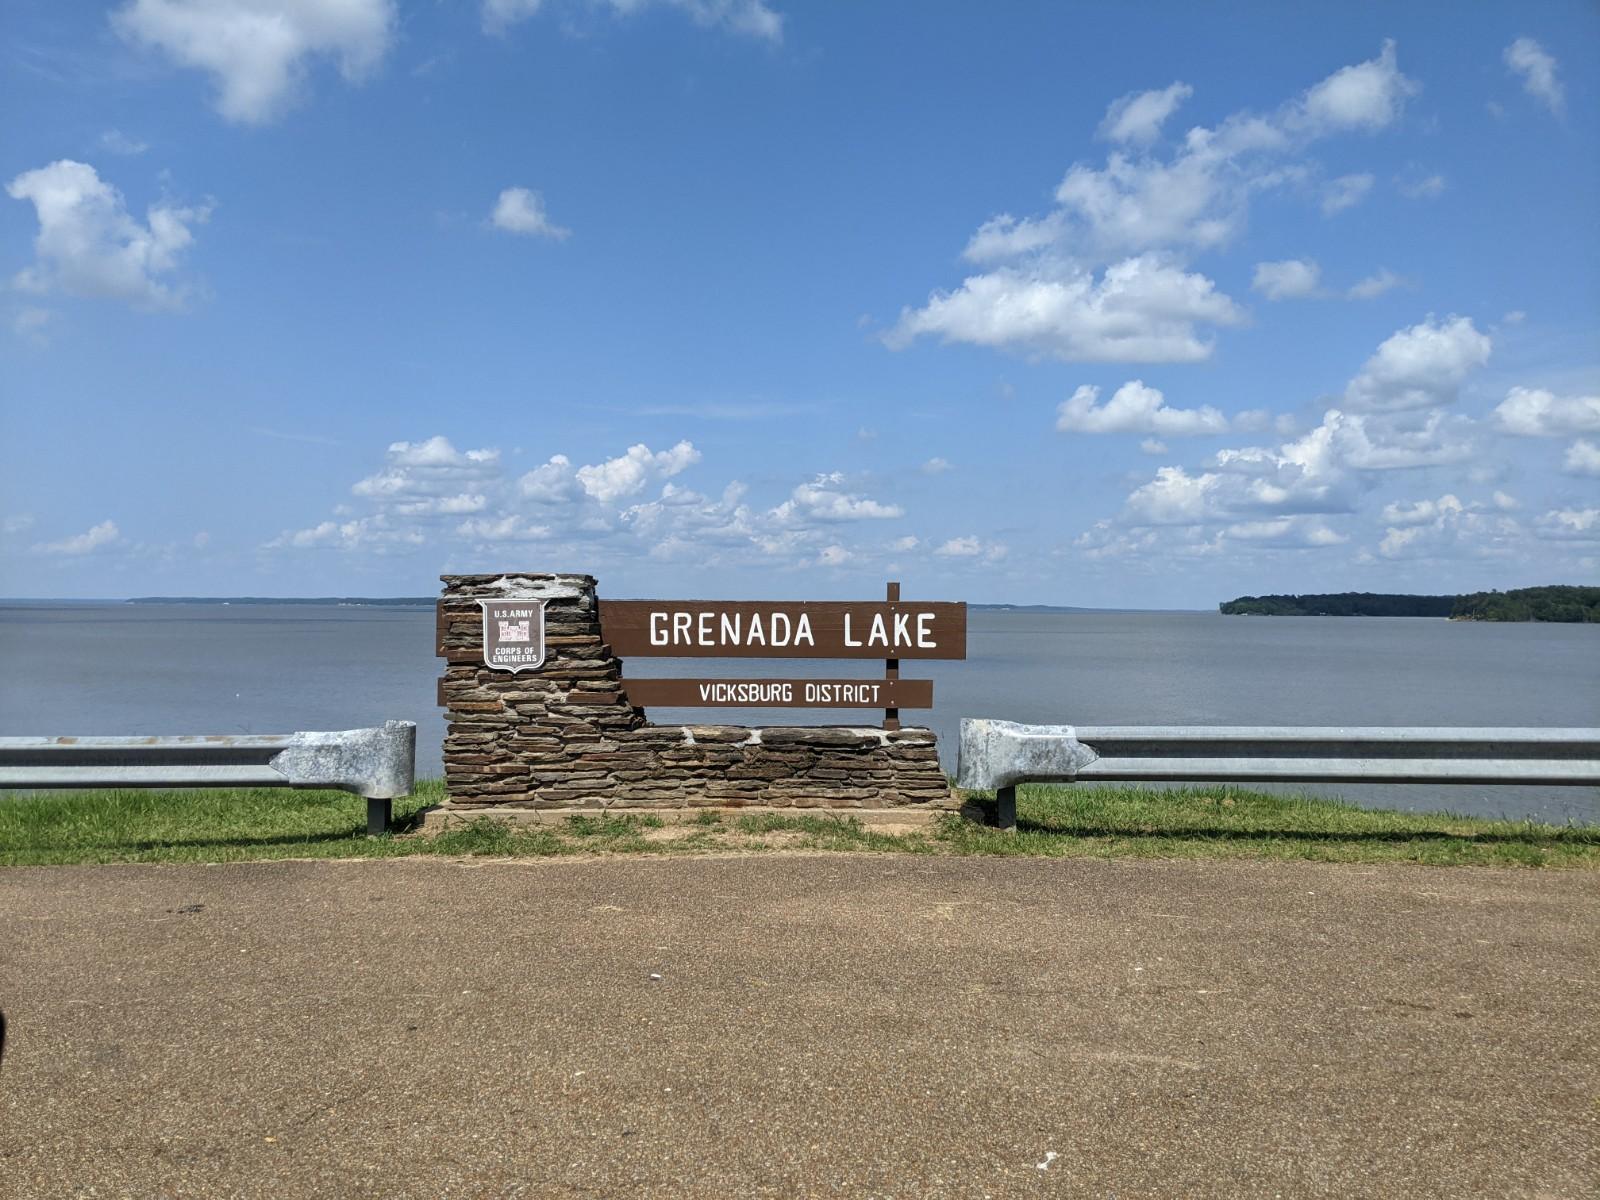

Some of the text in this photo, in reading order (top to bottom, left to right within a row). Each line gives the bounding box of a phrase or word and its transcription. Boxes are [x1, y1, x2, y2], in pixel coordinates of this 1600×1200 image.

[650, 612, 937, 648] GRENADA LAKE
[495, 646, 534, 655] CORPS OF
[493, 655, 537, 663] ENGINEERS
[699, 683, 881, 703] VICKSBURG DISTRICT
